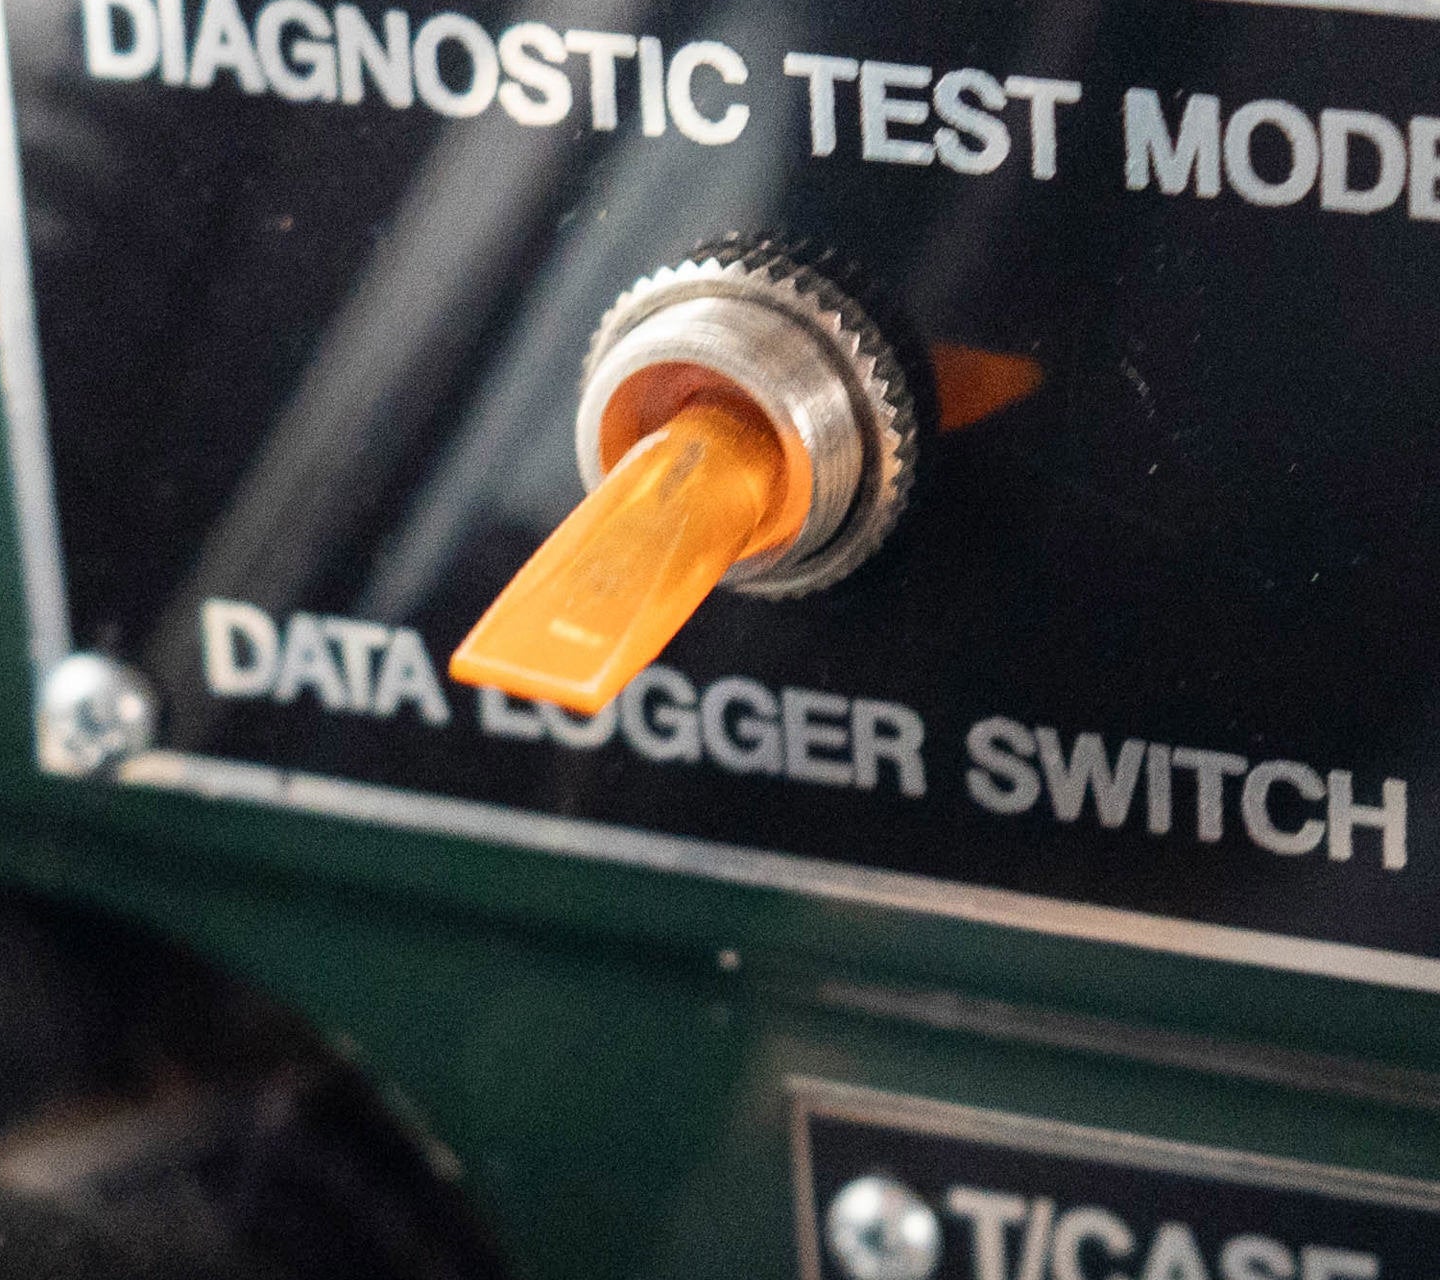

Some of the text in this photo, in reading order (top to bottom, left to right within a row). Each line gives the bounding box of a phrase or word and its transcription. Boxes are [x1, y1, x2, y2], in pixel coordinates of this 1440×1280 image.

[783, 51, 1082, 180] TEST
[202, 598, 451, 725] DATA
[965, 716, 1407, 871] SWITCH
